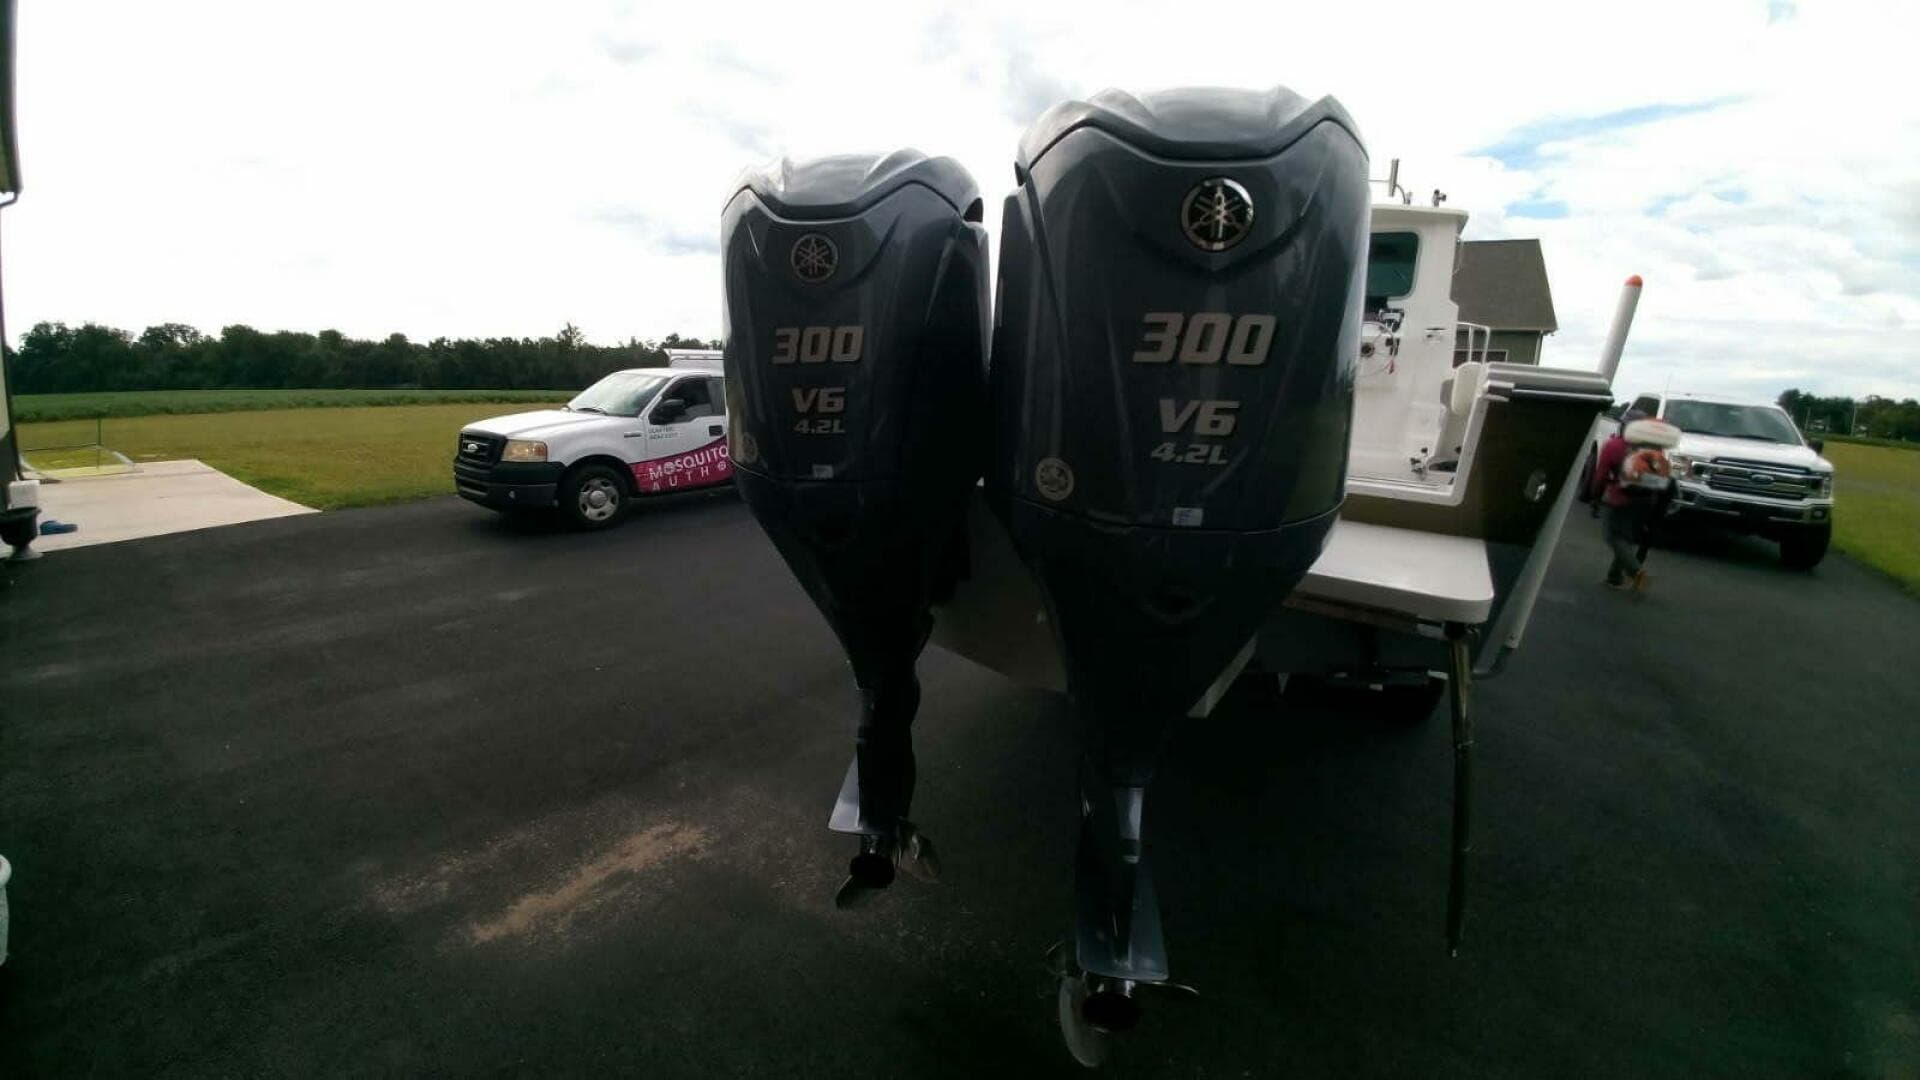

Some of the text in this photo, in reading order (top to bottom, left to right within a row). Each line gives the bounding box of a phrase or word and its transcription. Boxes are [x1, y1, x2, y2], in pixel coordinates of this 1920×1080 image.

[772, 326, 864, 364] 300
[1132, 312, 1277, 365] 300
[792, 387, 846, 413] V6
[1158, 399, 1239, 435] V6
[794, 418, 846, 434] 4.2L
[648, 445, 728, 481] MOSQUITO
[1151, 442, 1229, 464] 4.2L
